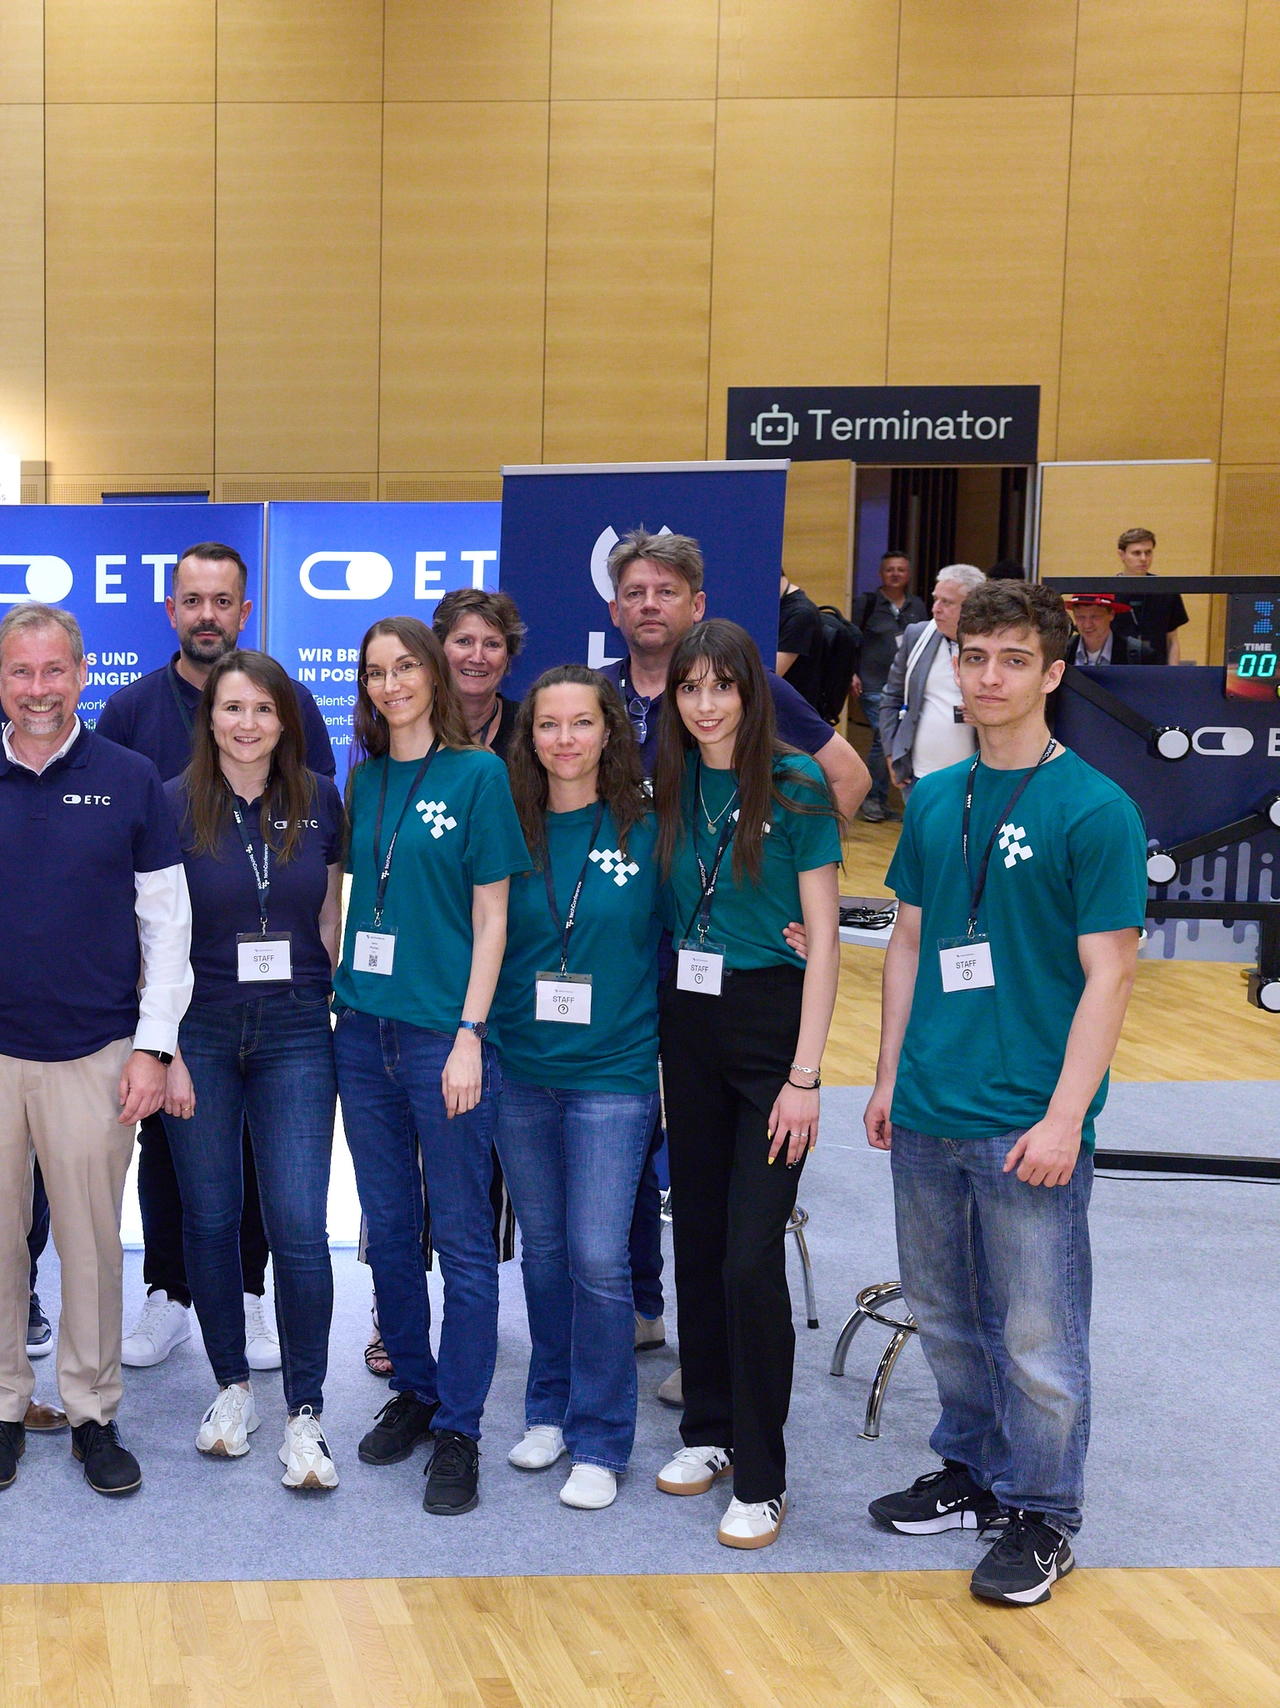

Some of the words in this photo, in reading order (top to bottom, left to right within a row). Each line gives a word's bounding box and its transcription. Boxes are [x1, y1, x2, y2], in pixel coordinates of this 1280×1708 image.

[808, 409, 1013, 441] Terminator
[95, 554, 178, 604] ET
[414, 550, 498, 600] ET
[1243, 642, 1273, 652] TIME
[101, 652, 139, 666] UND
[298, 647, 333, 662] WIR
[336, 648, 361, 662] BR
[1236, 653, 1278, 678] 00
[85, 672, 142, 686] UNGEN
[298, 667, 317, 682] IN
[84, 794, 111, 806] ETC
[253, 954, 275, 963] STAFF
[955, 958, 977, 970] STAFF
[690, 964, 709, 973] STAFF
[552, 995, 575, 1004] STAFF
